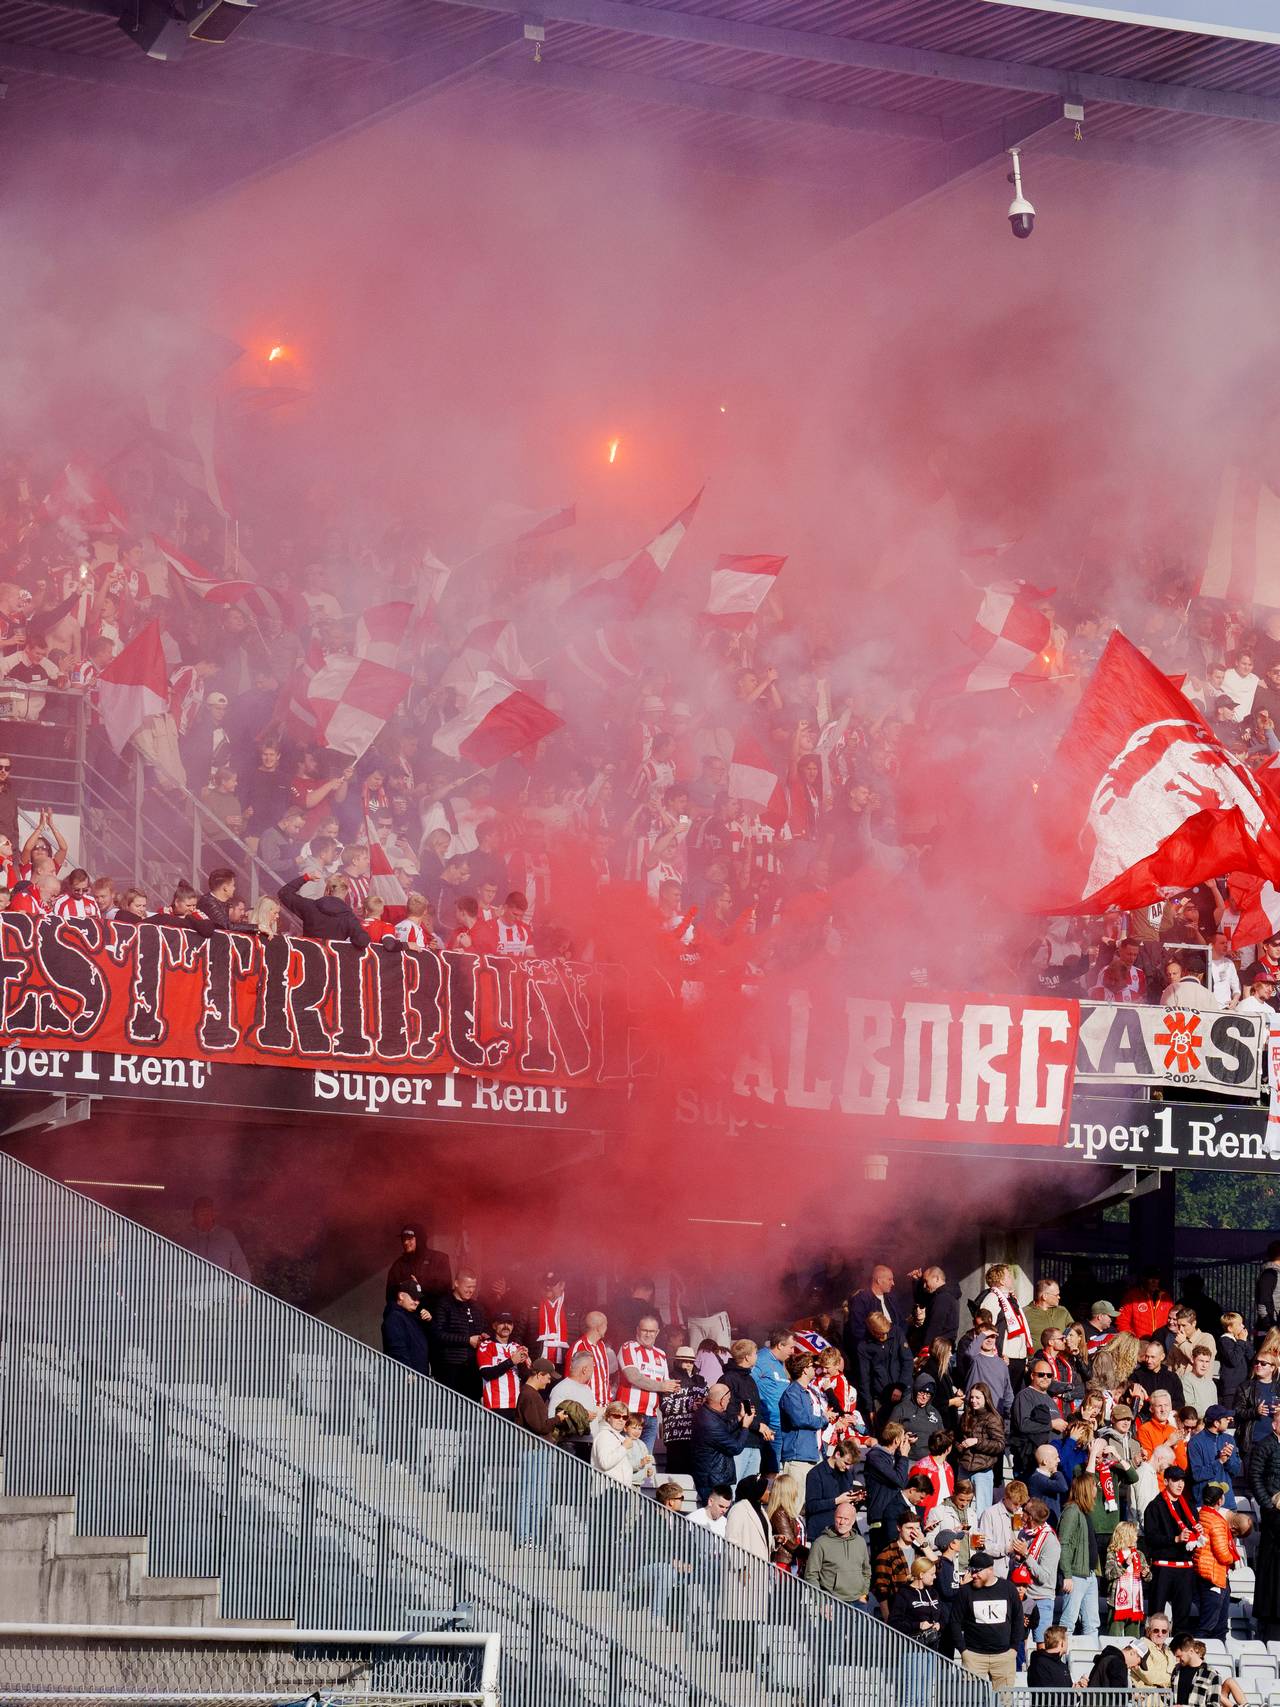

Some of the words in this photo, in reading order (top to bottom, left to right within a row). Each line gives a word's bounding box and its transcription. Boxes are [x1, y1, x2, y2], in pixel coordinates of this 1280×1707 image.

[0, 1047, 70, 1085] per
[109, 1053, 205, 1089] Rent
[314, 1069, 432, 1113] Super
[437, 1066, 462, 1108] 1
[471, 1074, 567, 1114] Rent
[1163, 1072, 1198, 1083] 2002
[1064, 1123, 1149, 1160] uper
[1154, 1107, 1179, 1155] 1
